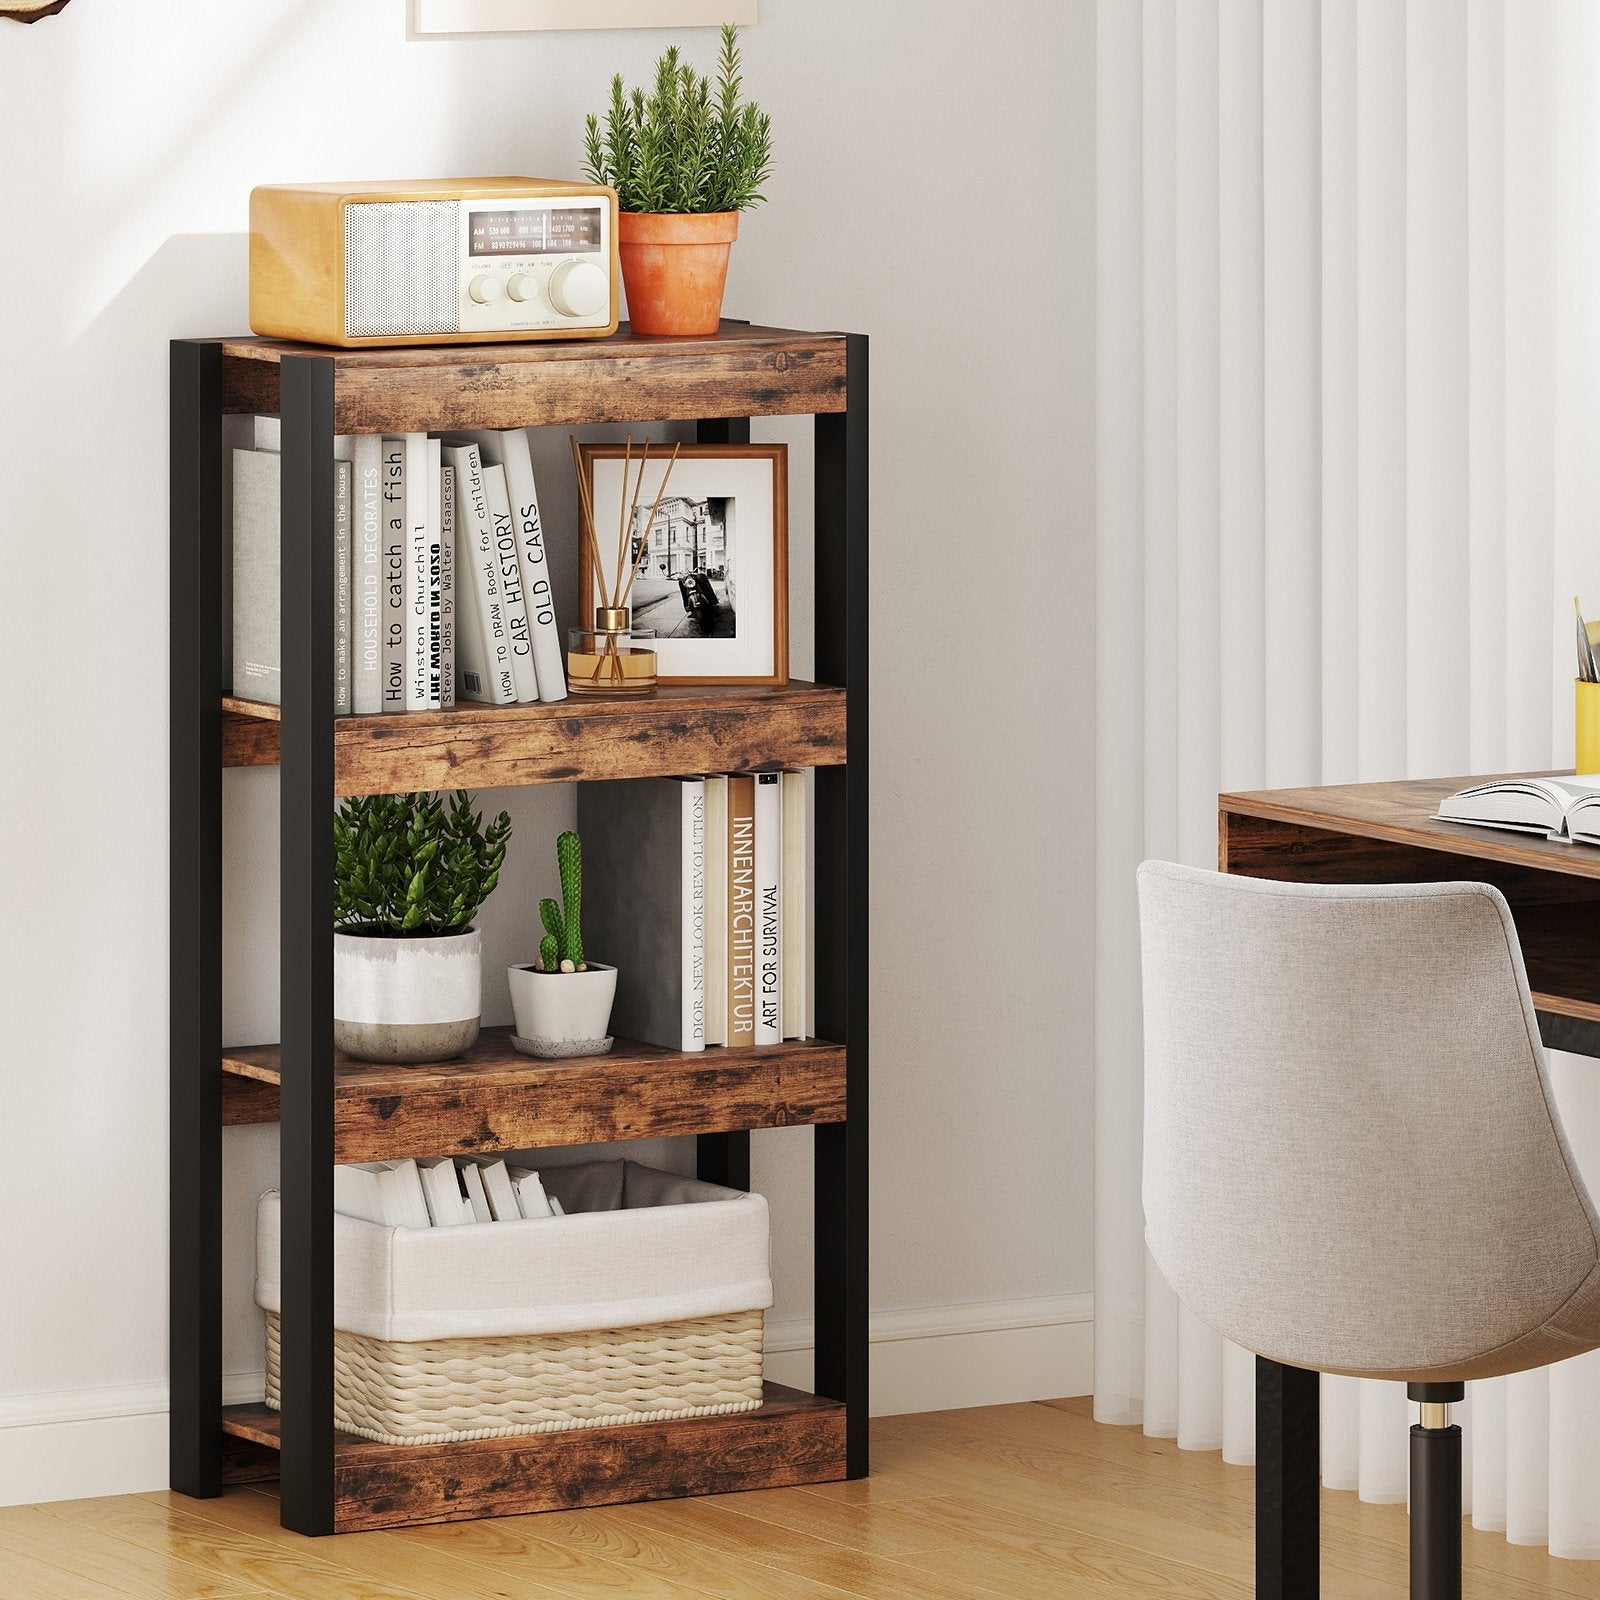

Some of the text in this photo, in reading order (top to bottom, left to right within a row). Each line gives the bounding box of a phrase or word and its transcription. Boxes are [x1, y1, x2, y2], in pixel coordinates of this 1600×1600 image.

[489, 227, 499, 235] 530
[530, 225, 542, 233] 1000
[338, 468, 348, 706] How to make an arrangement in the house
[364, 467, 378, 670] HOUSEHOLD DECORATES
[384, 452, 402, 701] How to catch a fish
[414, 523, 426, 699] Winston Churchill
[442, 469, 454, 702] Steve Jobs by Walter Isaacson
[467, 452, 512, 696] HOW TO DRAW Book for children
[493, 512, 530, 656] CAR HISTORY
[520, 503, 554, 626] OLD CARS
[693, 795, 704, 1040] DIOR. NEW LOOK REVOLUTION
[733, 816, 753, 1033] INNENARCHITEKTUR
[763, 884, 777, 1029] ART FOR SURVIVAL
